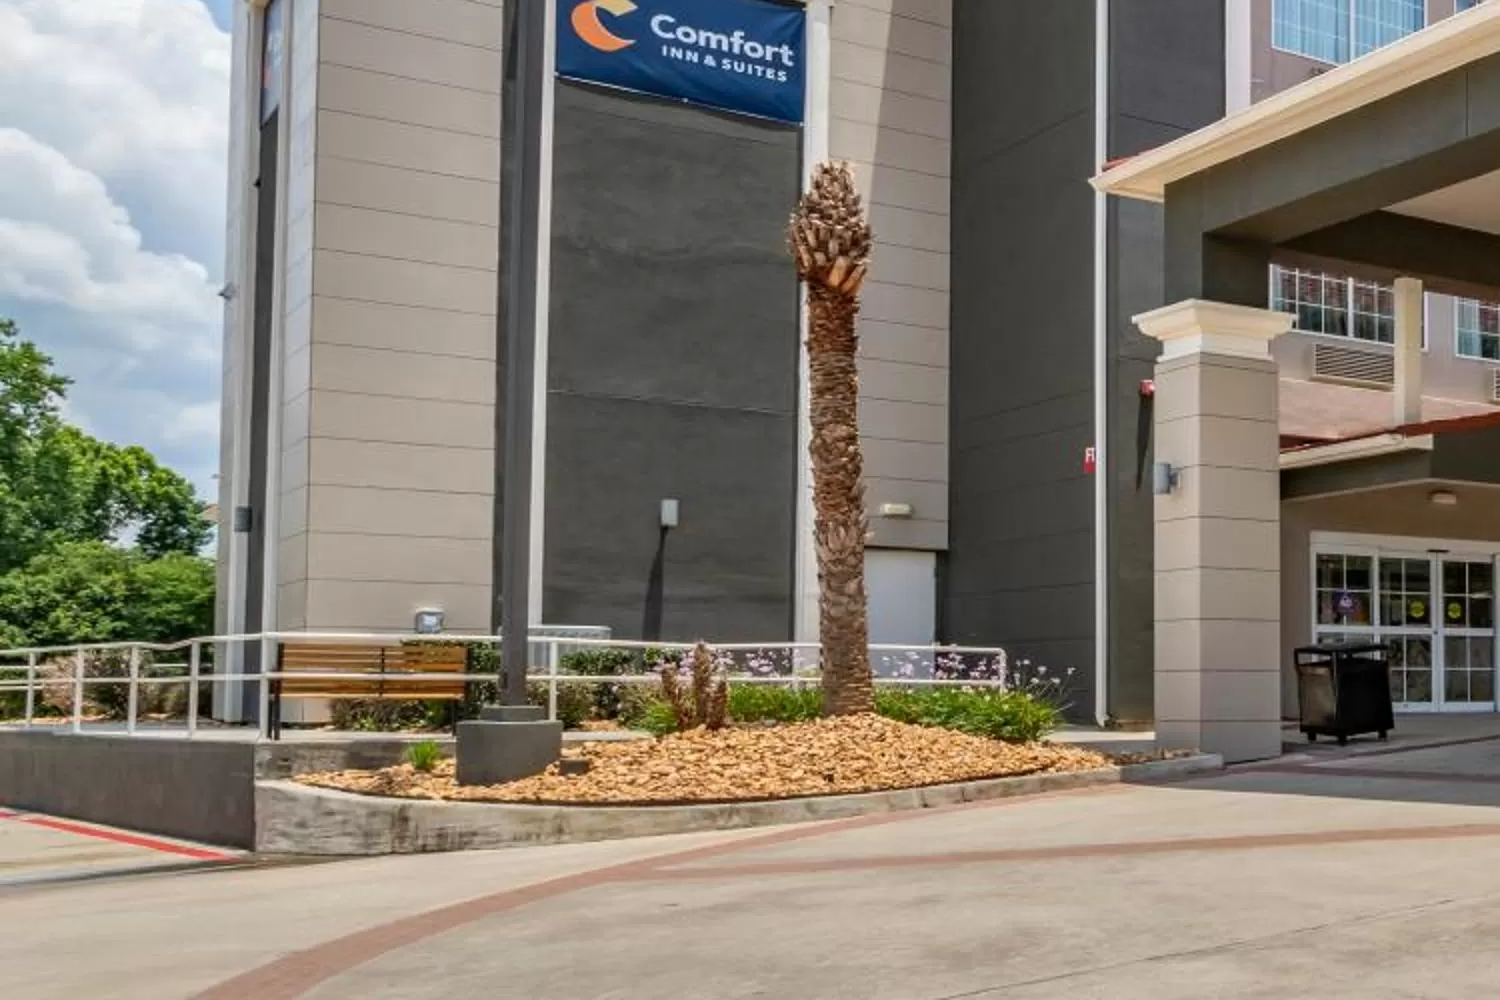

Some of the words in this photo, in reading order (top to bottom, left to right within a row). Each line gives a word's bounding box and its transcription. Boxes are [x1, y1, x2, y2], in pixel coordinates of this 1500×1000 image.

[650, 13, 796, 68] Comfort
[661, 44, 699, 64] INN
[703, 54, 717, 68] &
[721, 57, 788, 83] SUITES
